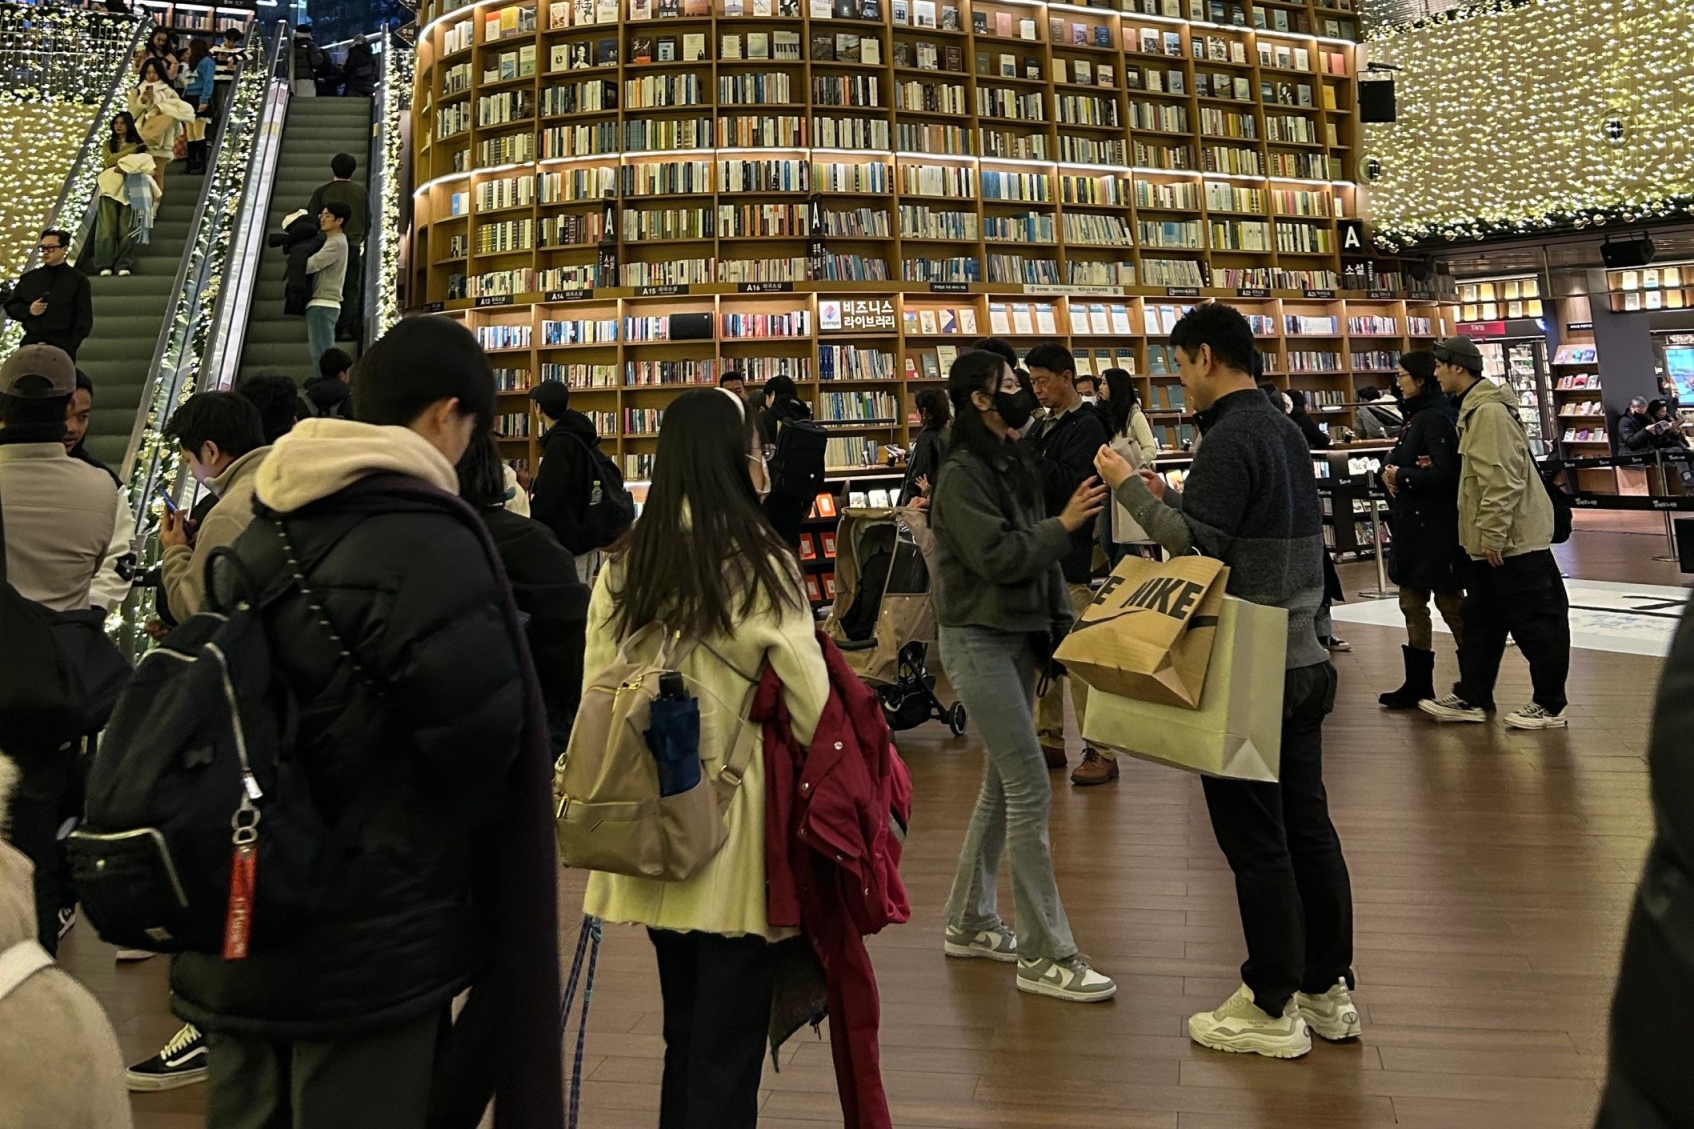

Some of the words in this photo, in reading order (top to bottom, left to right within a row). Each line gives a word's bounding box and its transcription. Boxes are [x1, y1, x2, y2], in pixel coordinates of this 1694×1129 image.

[605, 208, 614, 235] A
[812, 202, 820, 229] A
[1344, 225, 1361, 248] A
[1345, 263, 1364, 275] 소설
[642, 287, 656, 295] A15
[746, 283, 760, 291] A16
[551, 292, 564, 301] A14
[843, 300, 894, 315] 비즈니스
[844, 315, 895, 329] 라이브러리
[1119, 577, 1205, 620] NIKE
